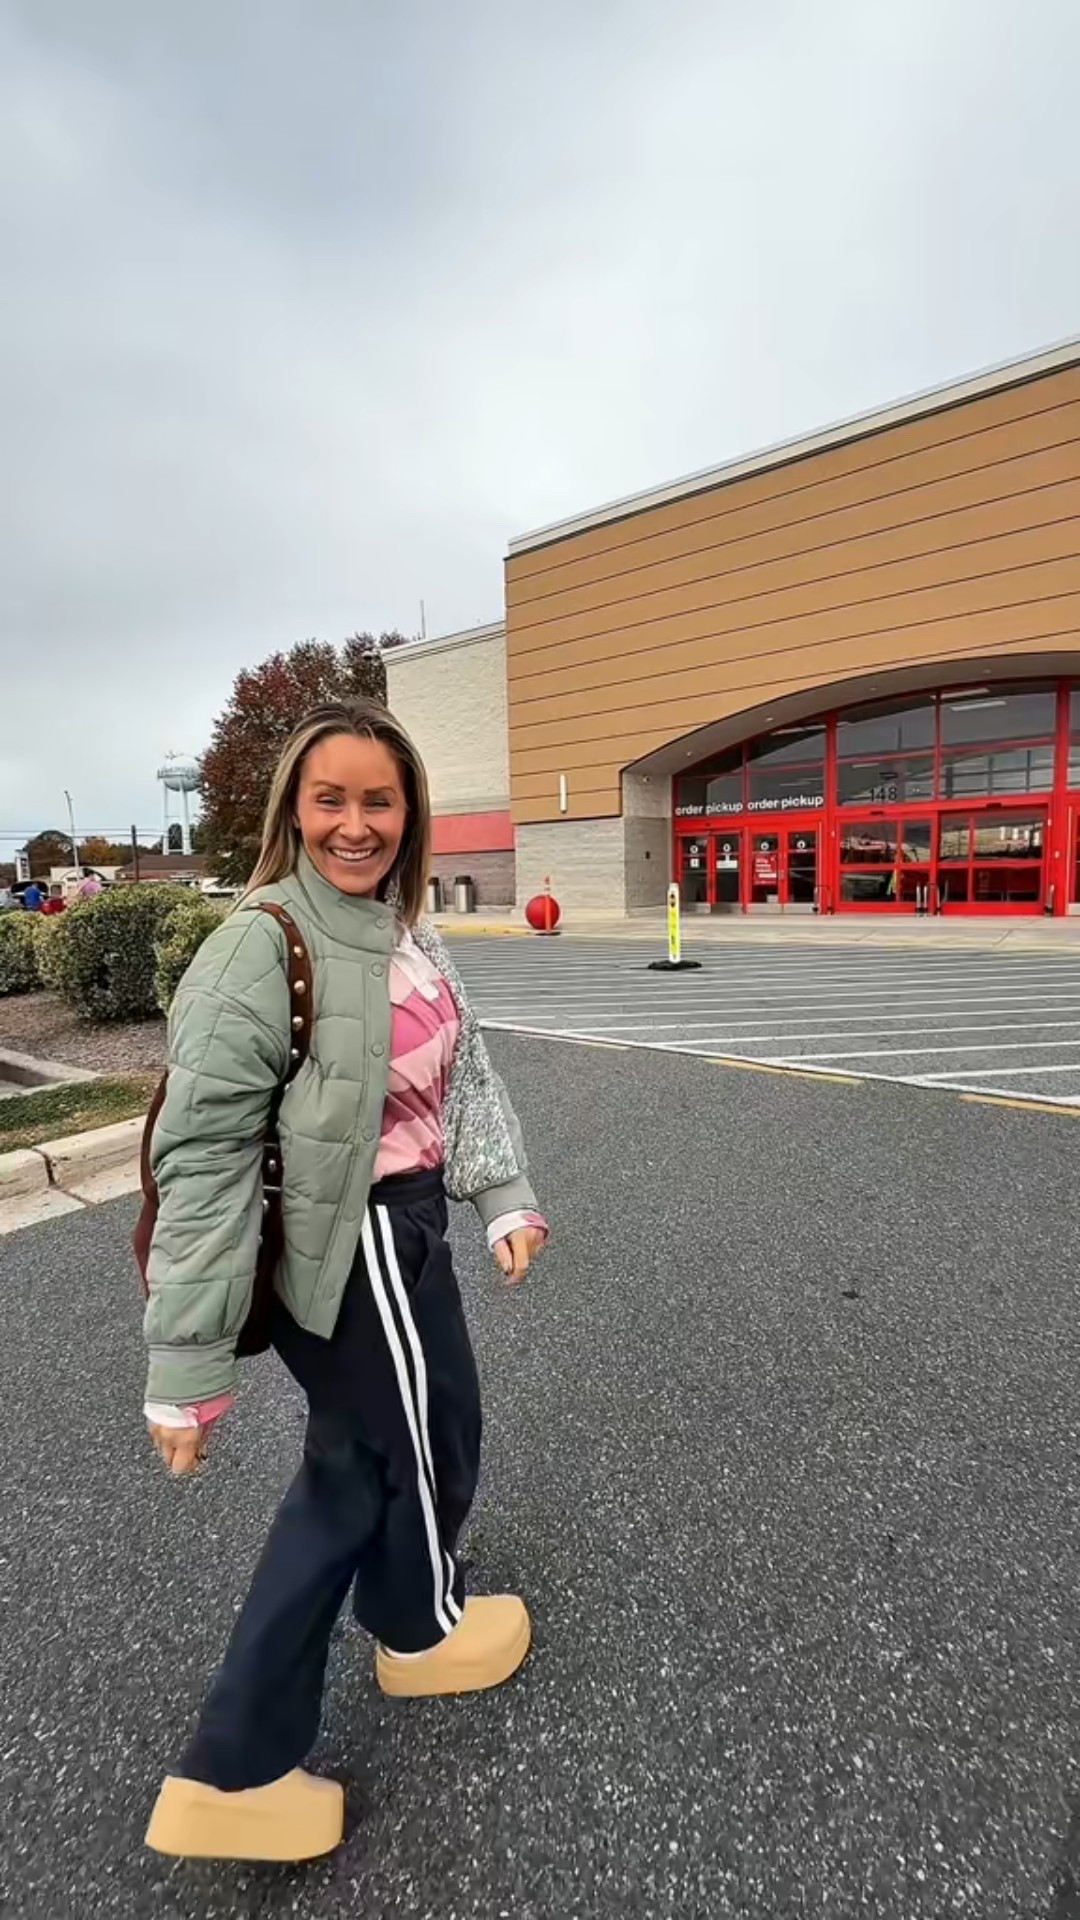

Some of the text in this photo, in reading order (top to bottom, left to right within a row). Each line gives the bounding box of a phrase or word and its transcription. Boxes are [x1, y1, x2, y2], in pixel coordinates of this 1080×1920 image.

[870, 786, 897, 802] 148
[675, 801, 743, 816] order pickup
[748, 795, 824, 811] order pickup
